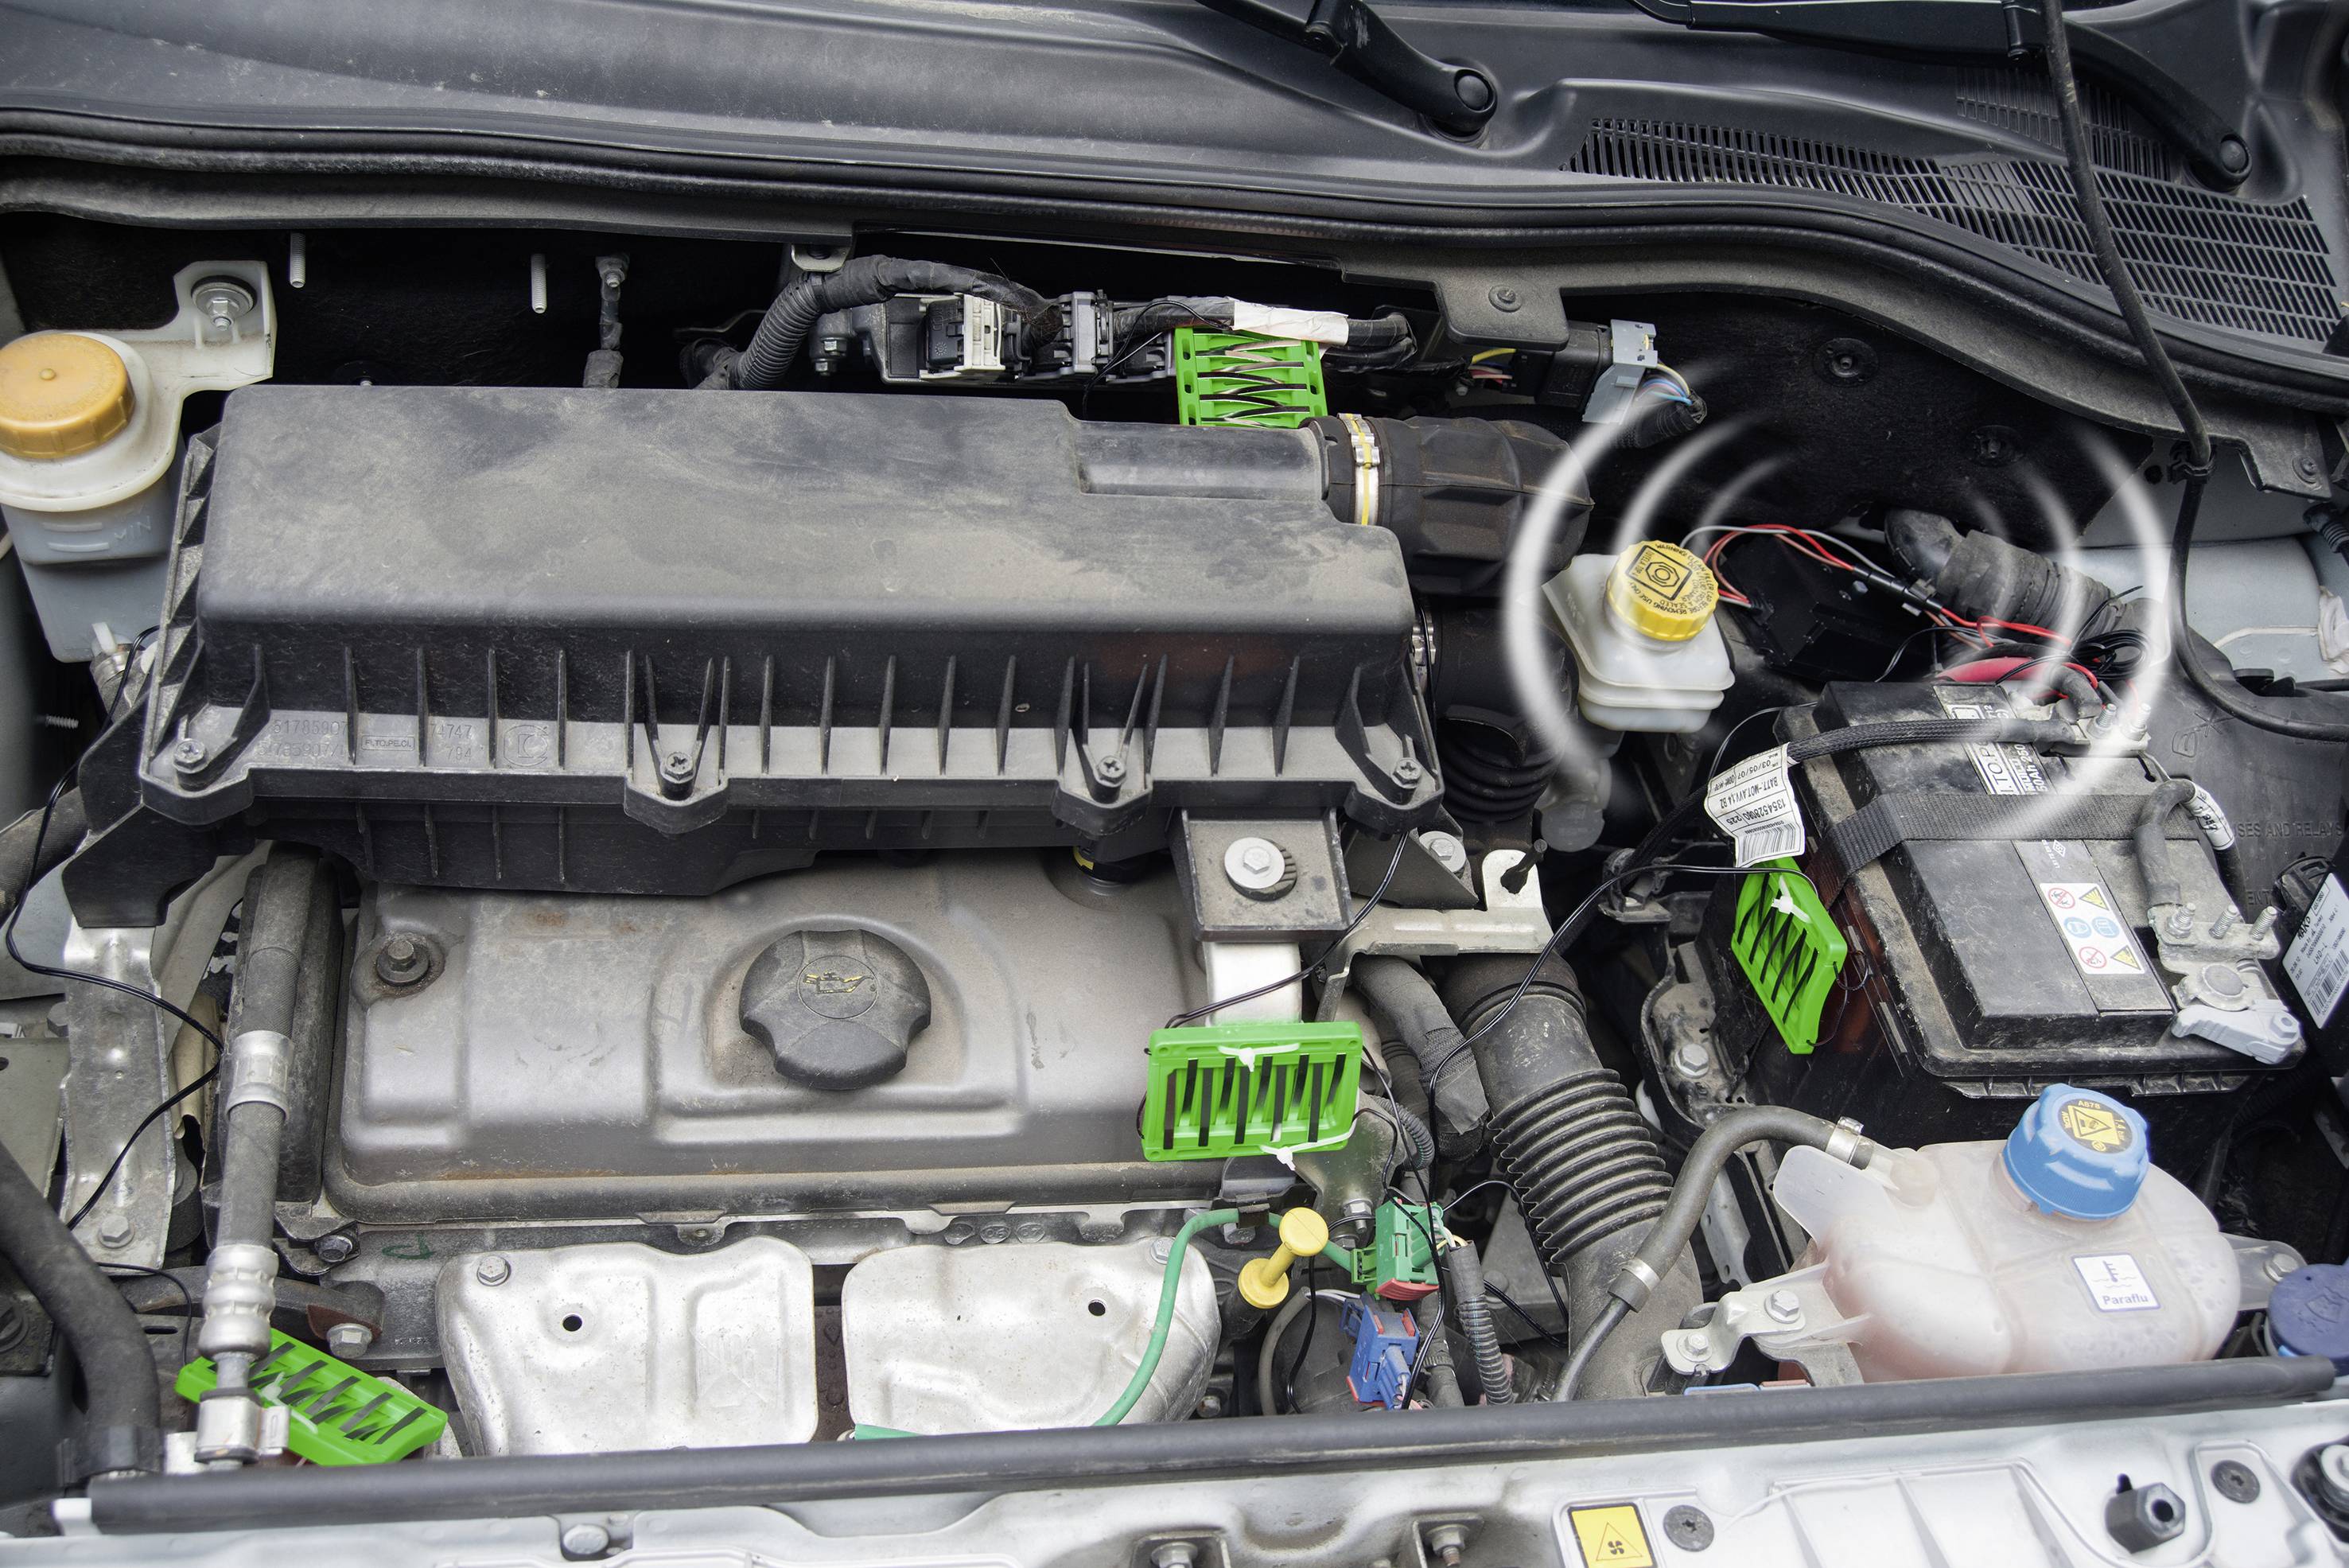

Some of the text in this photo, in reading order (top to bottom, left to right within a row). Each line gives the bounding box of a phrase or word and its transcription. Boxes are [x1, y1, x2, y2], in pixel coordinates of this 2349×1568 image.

[114, 516, 151, 543] MIN
[1640, 551, 1655, 566] TUTELA
[1688, 555, 1705, 571] CLEAN
[1629, 582, 1641, 594] ONLY
[1705, 572, 1713, 590] FILLER
[1640, 595, 1652, 604] USE
[1690, 601, 1708, 613] BEFORE
[1654, 602, 1687, 614] REMOVING
[1737, 760, 1771, 780] 03/05/07
[2015, 743, 2048, 793] 50Ah 250
[1726, 815, 1742, 826] 225
[2267, 822, 2290, 837] AND
[2296, 821, 2343, 837] RELAYS
[2102, 1293, 2149, 1305] Paraflu
